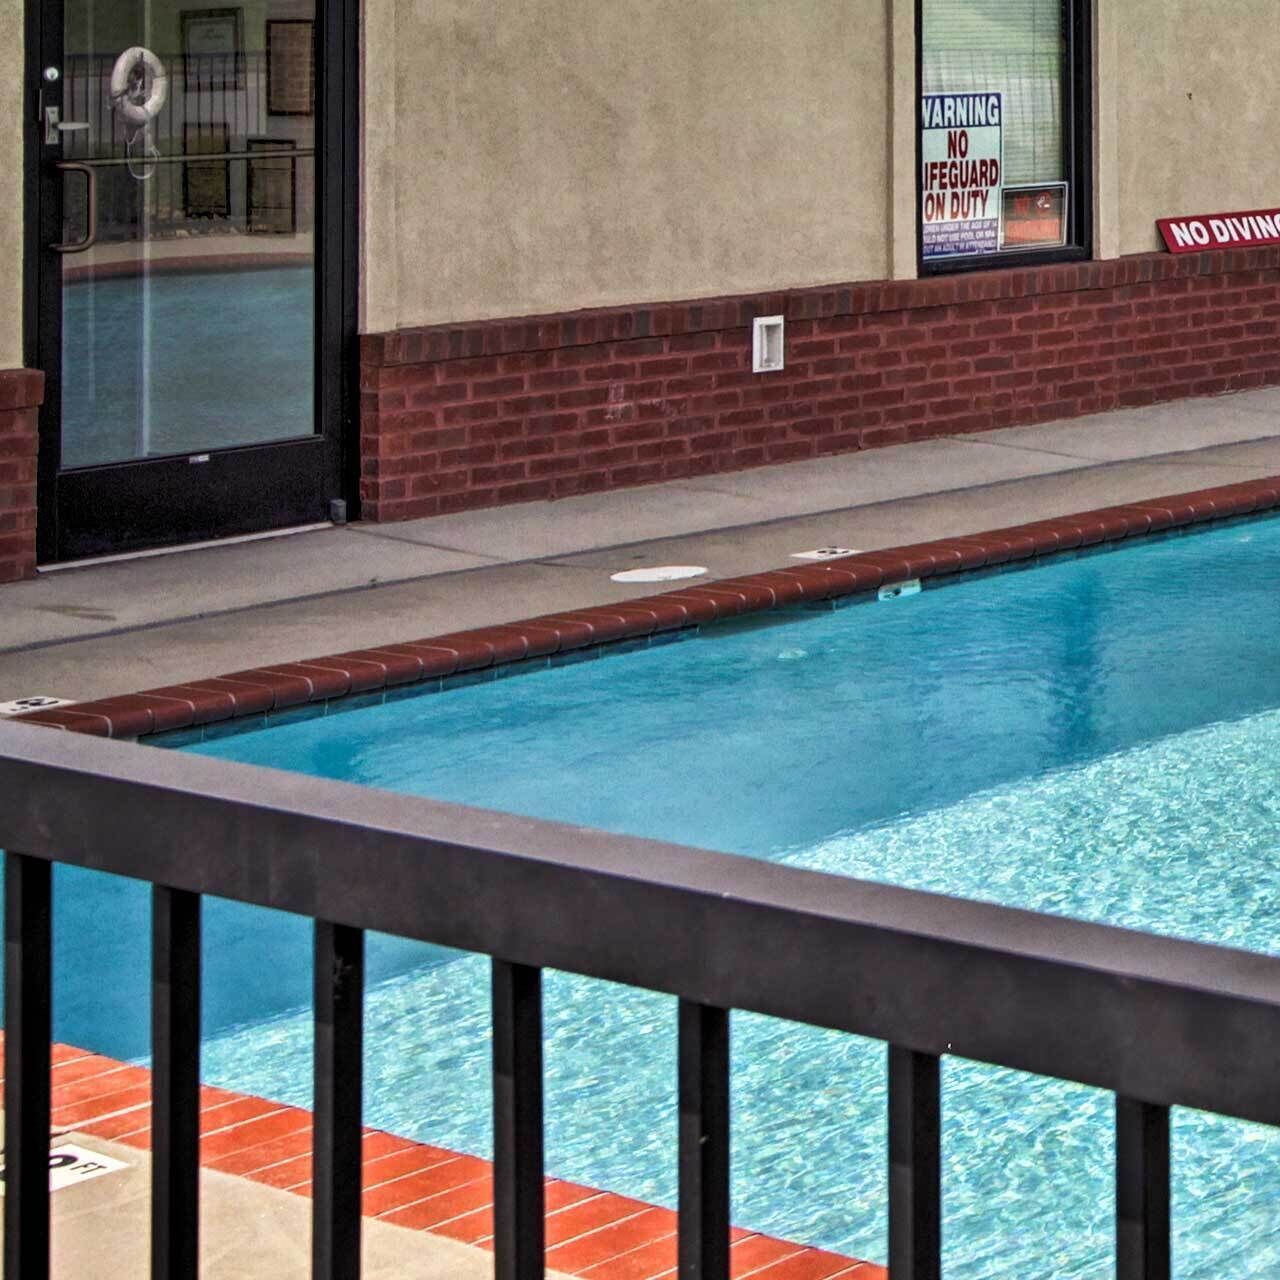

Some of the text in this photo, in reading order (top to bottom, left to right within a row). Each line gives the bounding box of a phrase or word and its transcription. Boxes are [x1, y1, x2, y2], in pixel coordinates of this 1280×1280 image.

[947, 129, 968, 159] NO
[924, 159, 999, 191] IFEGUARD
[924, 193, 946, 222] ON
[950, 189, 989, 219] DUTY
[1169, 220, 1210, 247] NO
